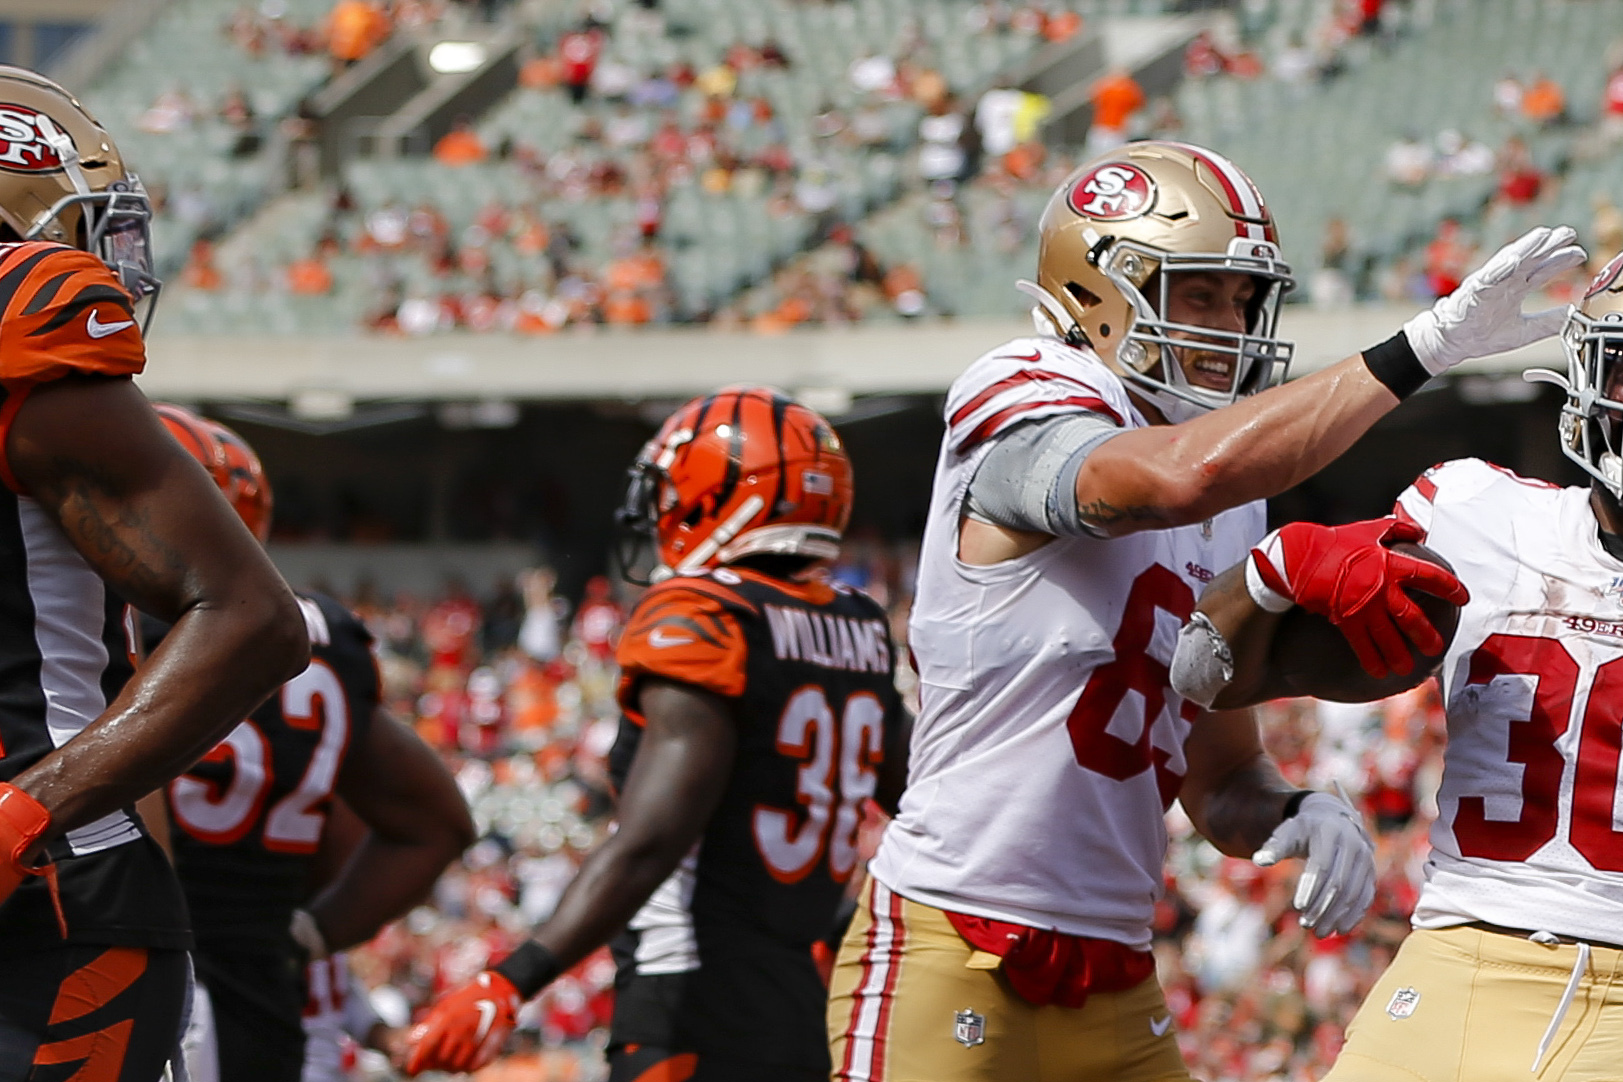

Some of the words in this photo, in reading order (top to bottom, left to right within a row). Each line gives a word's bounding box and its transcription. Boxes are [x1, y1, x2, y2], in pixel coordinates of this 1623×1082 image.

[764, 602, 891, 674] WILLIAMS
[1067, 562, 1197, 813] 8
[753, 684, 885, 885] 36
